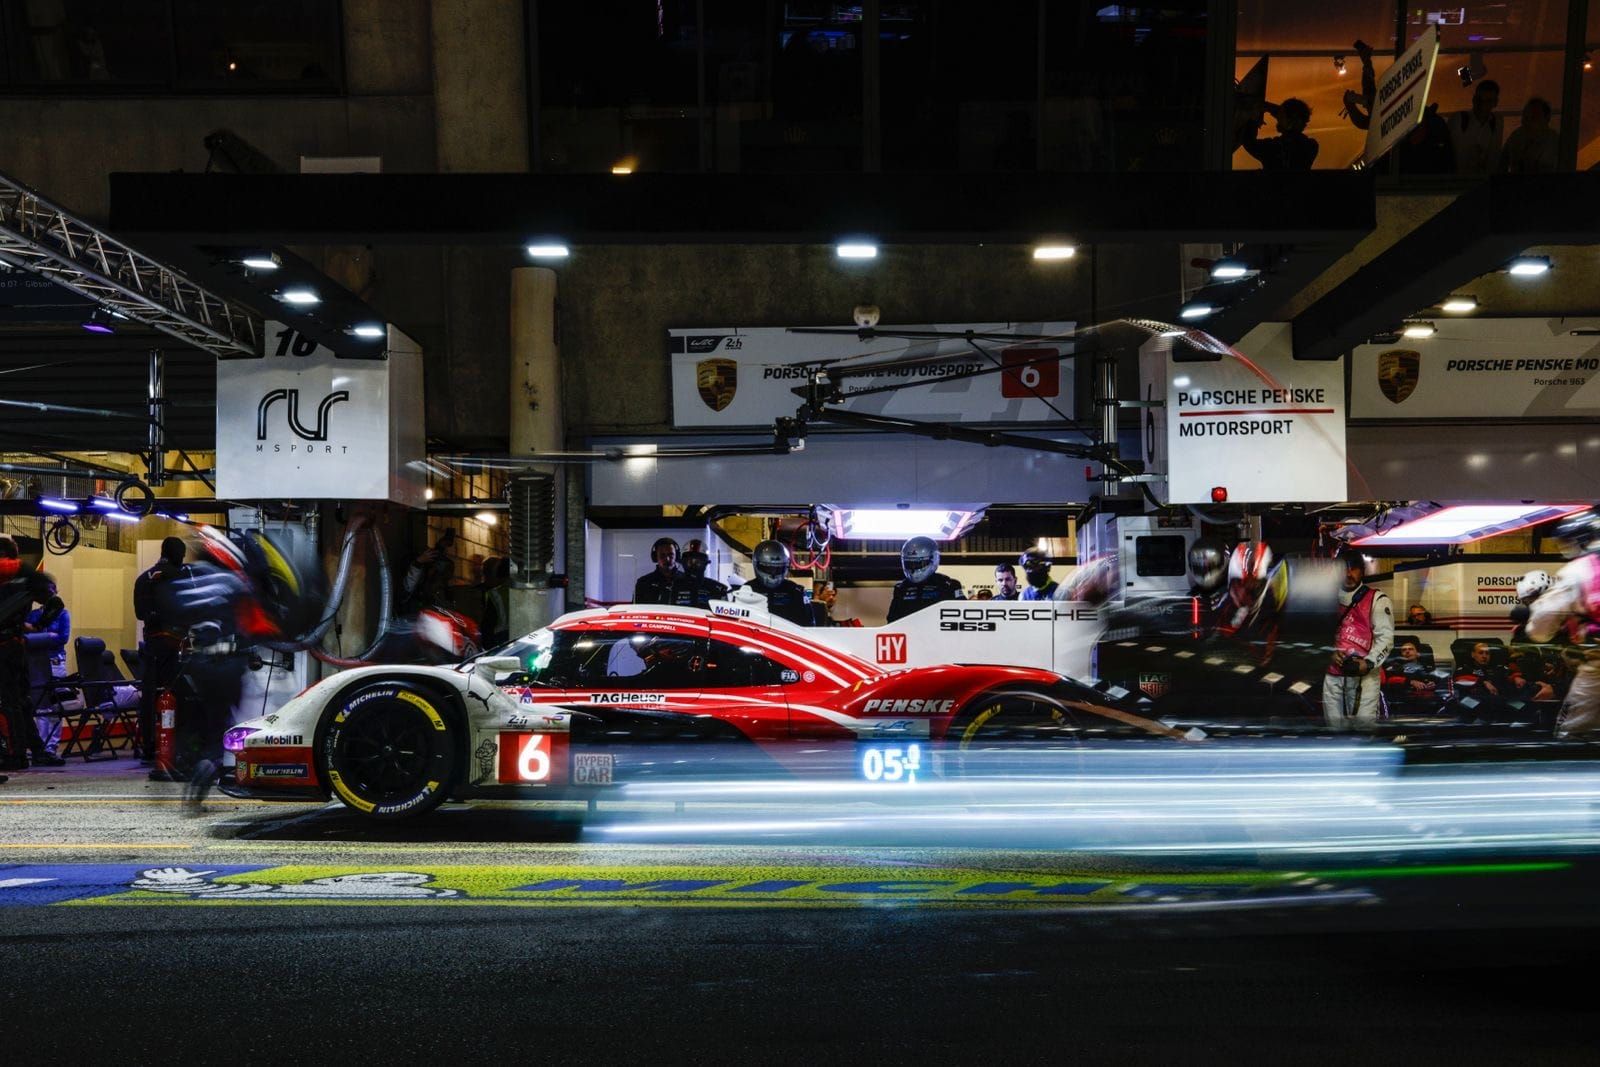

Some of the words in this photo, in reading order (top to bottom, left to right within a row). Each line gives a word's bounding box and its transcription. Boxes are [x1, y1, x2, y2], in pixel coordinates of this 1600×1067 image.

[1380, 71, 1402, 105] PORSCHE
[1402, 49, 1423, 85] PENSKE
[1380, 96, 1414, 139] MOTORSPORT
[1446, 359, 1513, 371] PORSCHE
[1515, 358, 1573, 371] PENSKE
[764, 367, 824, 379] PORSCH
[1020, 358, 1041, 388] 6
[1533, 378, 1567, 386] Porsche
[1569, 377, 1586, 386] 963
[1178, 390, 1257, 406] PORSCHE
[1262, 388, 1325, 403] PENSKE
[1179, 420, 1294, 437] MOTORSPORT
[1477, 576, 1523, 586] PORSCH
[1478, 595, 1521, 605] MOTORS
[715, 606, 740, 616] Mobil
[939, 608, 1099, 621] PORSCHE
[939, 622, 997, 632] 963
[877, 636, 906, 662] HY
[782, 671, 798, 681] FIA
[1142, 674, 1169, 682] TAG
[348, 690, 394, 711] MICHELIN
[863, 699, 955, 713] PENSKE
[265, 735, 292, 745] Mobil
[518, 734, 551, 781] 6
[576, 756, 611, 766] HYPER
[576, 767, 610, 782] CAR
[377, 793, 426, 814] MICHELIN
